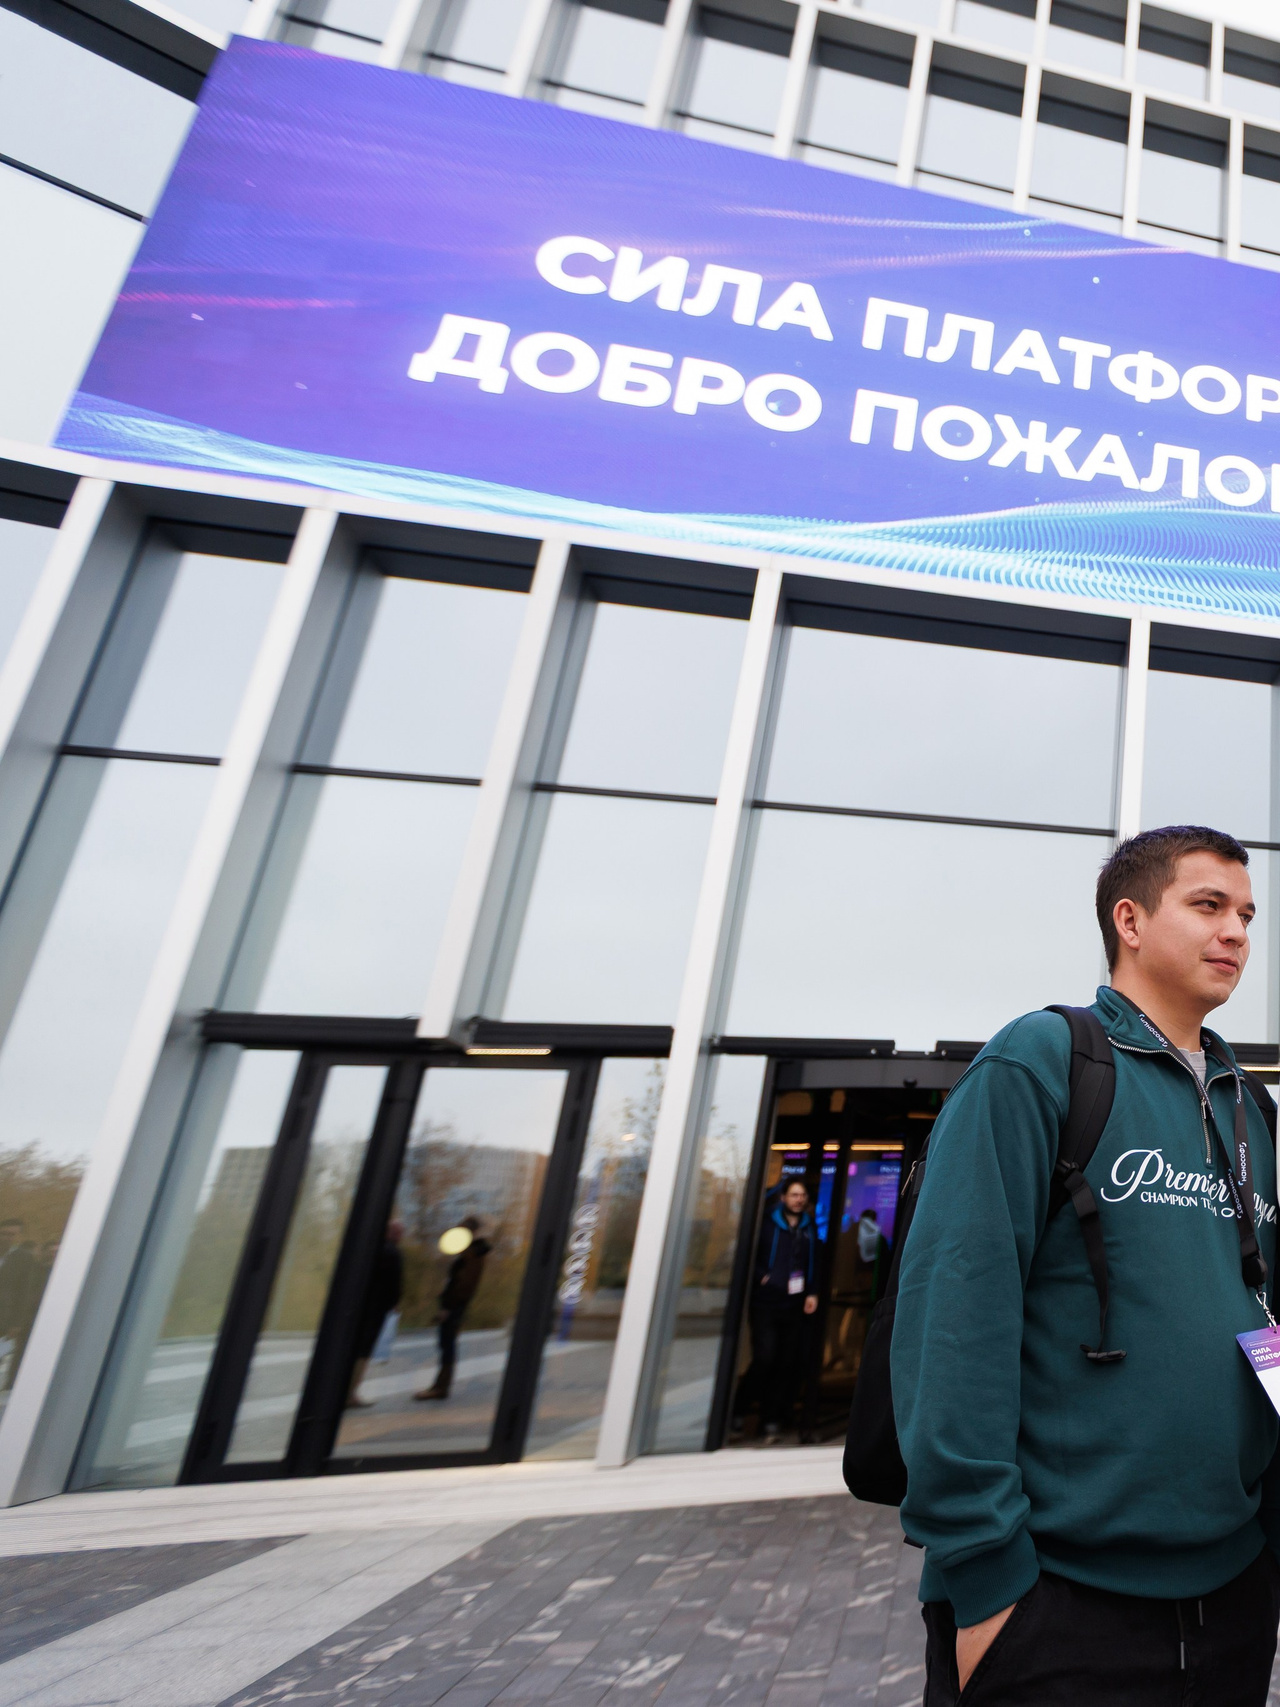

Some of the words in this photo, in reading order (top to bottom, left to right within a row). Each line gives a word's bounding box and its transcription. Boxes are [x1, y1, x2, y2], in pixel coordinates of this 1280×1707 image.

[534, 234, 835, 343] СИЛА
[407, 313, 824, 432] ДОБРО
[1101, 1148, 1230, 1203] Premier
[1140, 1191, 1198, 1207] CHAMPION
[1250, 1346, 1272, 1356] СИЛА
